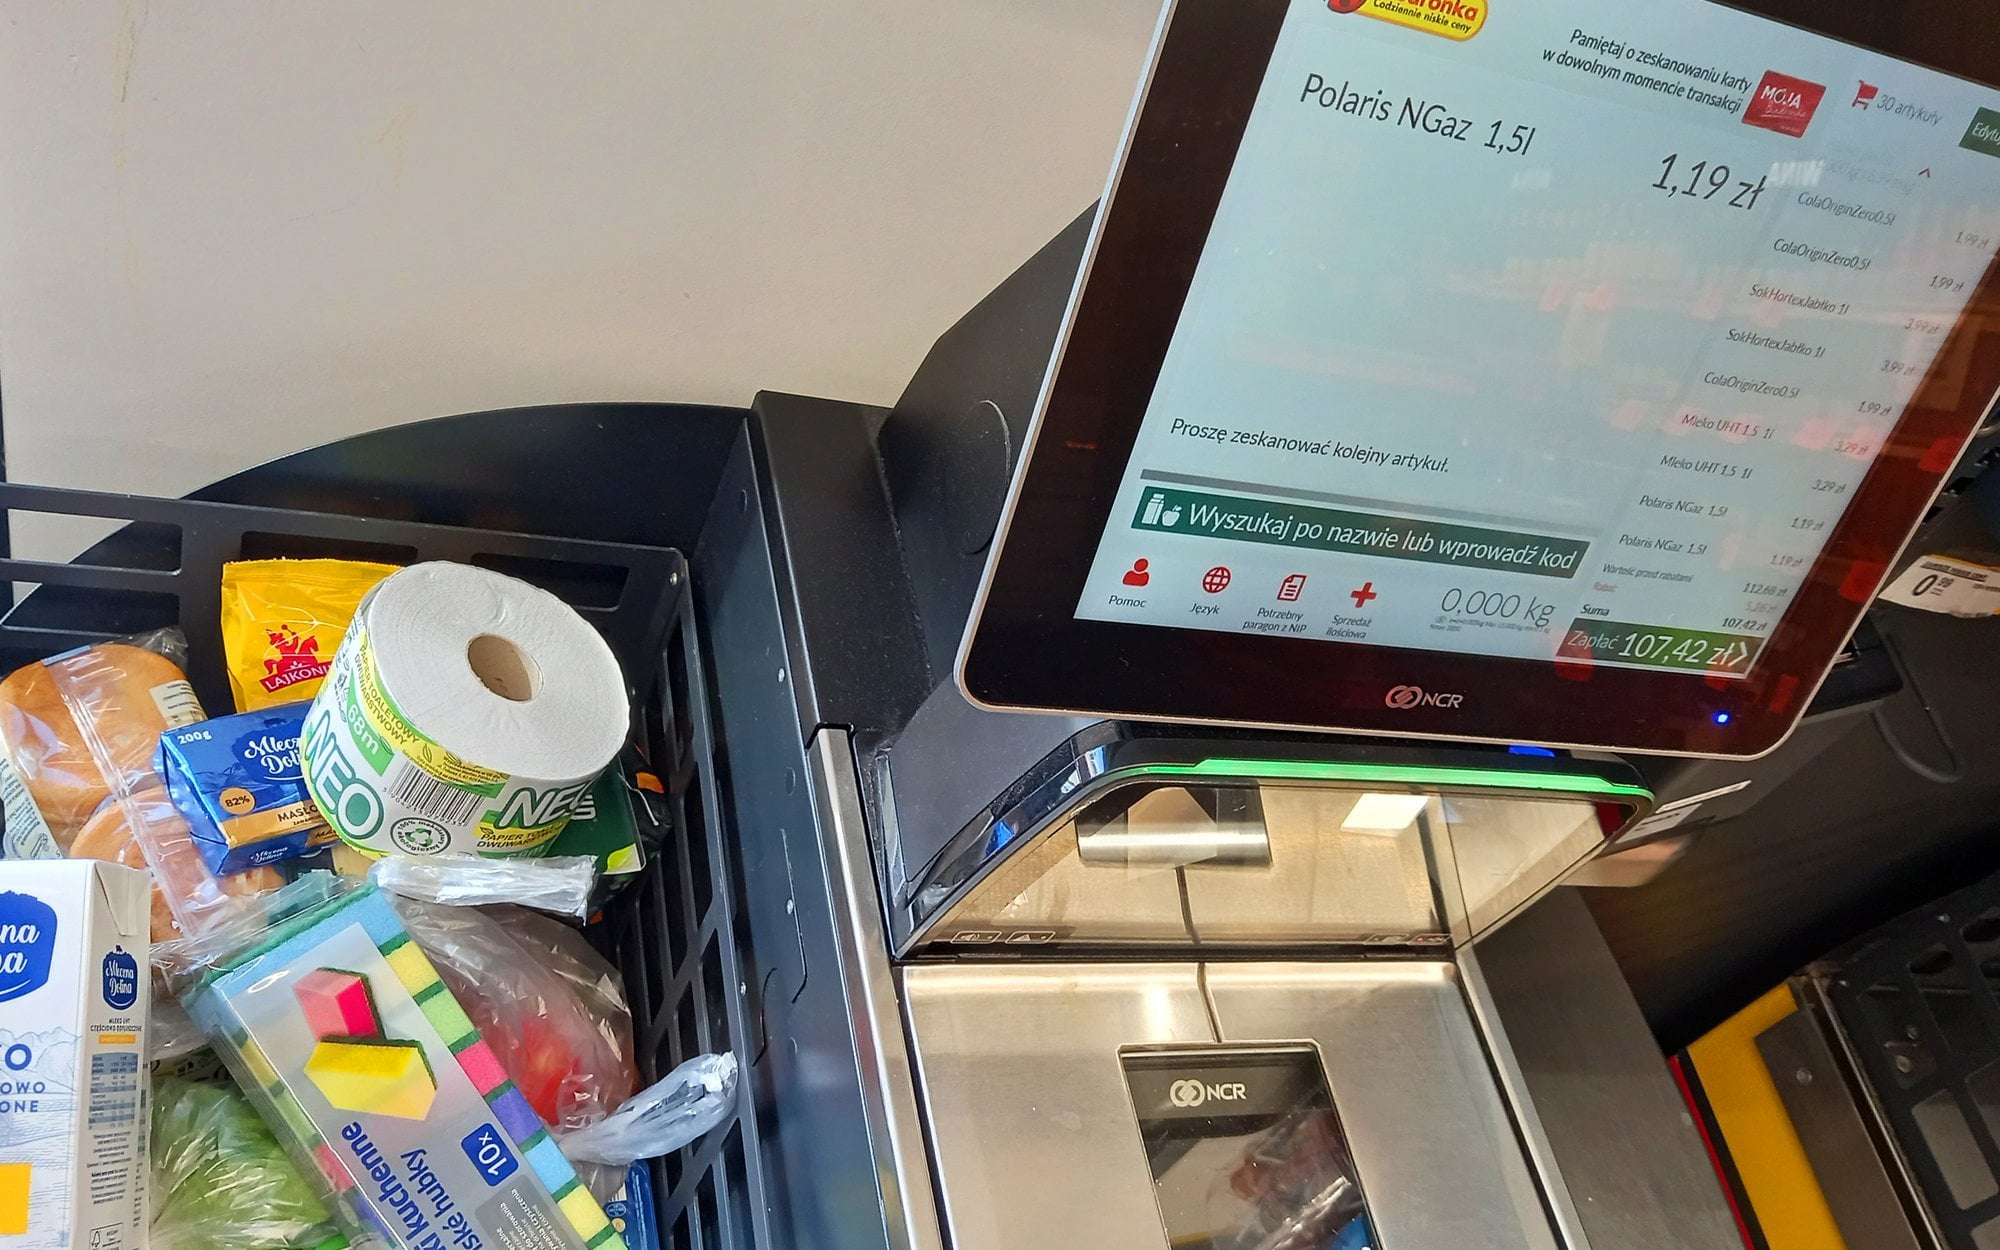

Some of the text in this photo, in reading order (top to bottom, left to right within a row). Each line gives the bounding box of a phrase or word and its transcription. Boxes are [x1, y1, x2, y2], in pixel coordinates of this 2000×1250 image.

[1424, 12, 1449, 26] niskie
[1450, 21, 1472, 34] ceny
[1570, 29, 1752, 94] Pamiętaj o zeskanowaniu karty
[1542, 50, 1556, 62] w
[1557, 50, 1621, 78] dowolnym
[1622, 72, 1685, 97] momencie
[1686, 86, 1743, 115] transakcji
[1761, 85, 1801, 108] MOJA
[1300, 73, 1536, 156] Polaris NGaz 1,5l
[1877, 94, 1942, 127] 30 artykuły
[1652, 153, 1768, 210] 1,19 zł
[1929, 275, 1954, 290] 1,99
[1858, 400, 1882, 414] 1,99
[1682, 414, 1715, 430] Mleko
[1716, 420, 1742, 434] UHT
[1170, 418, 1450, 473] Proszę zeskanować kolejny artykuł.
[1660, 455, 1693, 470] Mleko
[1694, 460, 1719, 474] UHT
[1812, 479, 1836, 492] 3,29
[1639, 495, 1674, 510] Polaris
[1674, 500, 1705, 515] NGaz
[1790, 516, 1815, 530] 1,19
[1187, 502, 1578, 570] Wyszukaj po nazwie lub wprowadź kod
[1618, 534, 1653, 550] Polaris
[1654, 538, 1684, 553] NGaz
[1108, 594, 1146, 609] Pomoc
[1189, 602, 1220, 617] Język
[1442, 588, 1520, 618] 0,000
[1524, 596, 1556, 628] kg
[1580, 604, 1610, 616] Suma
[1256, 607, 1304, 622] Potrzebny
[1332, 614, 1372, 627] Sprzedaż
[1722, 618, 1758, 631] 107,42
[1242, 620, 1280, 632] paragon
[1288, 623, 1306, 633] NIP
[1326, 626, 1366, 639] ilościowa
[1568, 630, 1736, 665] Zapłać 107,42 zł
[1421, 692, 1464, 710] NCR
[369, 682, 420, 744] TOALETOWY
[177, 729, 212, 746] 200g
[350, 704, 380, 756] 68m
[306, 710, 384, 840] NEO
[225, 794, 250, 808] 82%
[480, 833, 524, 841] PAPIER
[1206, 1083, 1247, 1101] NCR
[478, 1131, 508, 1177] 10x
[342, 1122, 429, 1240] kuchenne
[402, 1149, 454, 1218] hubky
[510, 1188, 540, 1226] czyszczenia
[501, 1203, 527, 1239] szorowania
